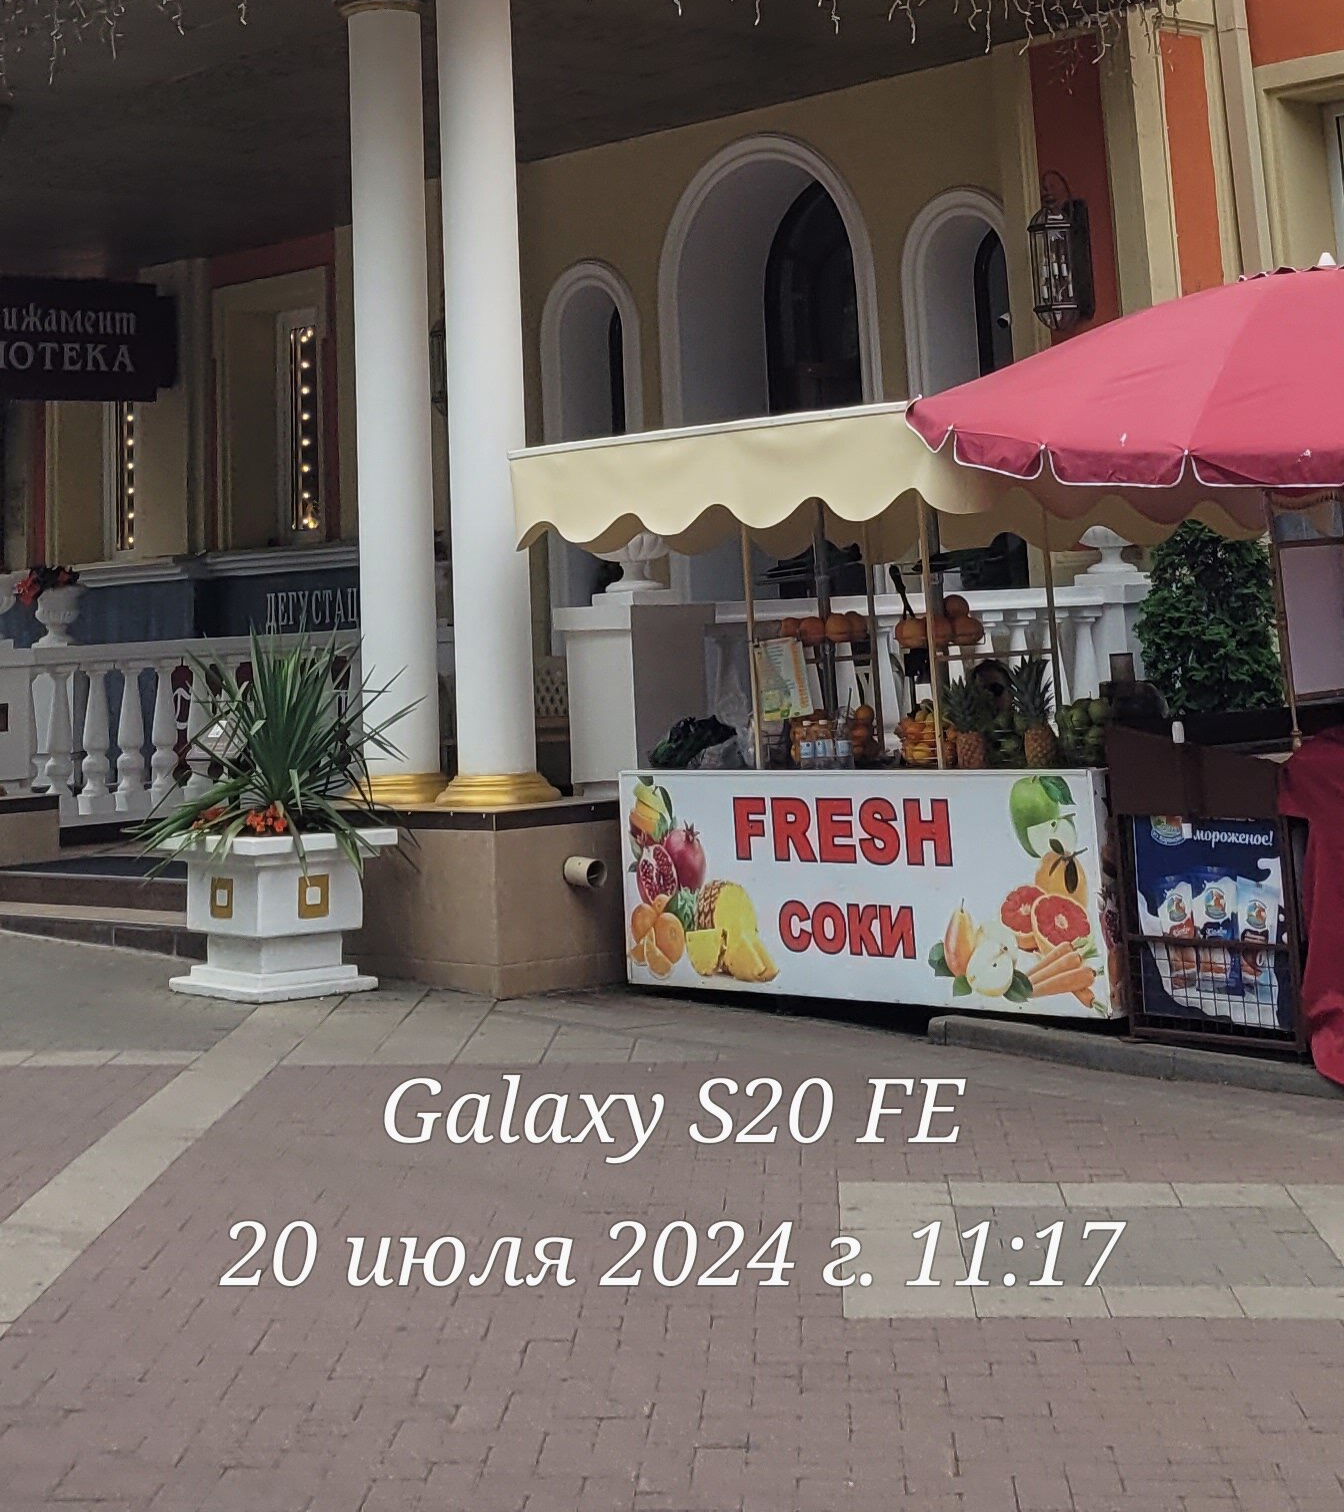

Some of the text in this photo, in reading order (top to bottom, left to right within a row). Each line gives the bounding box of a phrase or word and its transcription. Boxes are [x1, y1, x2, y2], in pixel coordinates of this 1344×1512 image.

[731, 795, 954, 867] FRESH
[1193, 829, 1274, 849] мороженое!
[777, 898, 918, 960] СОКИ
